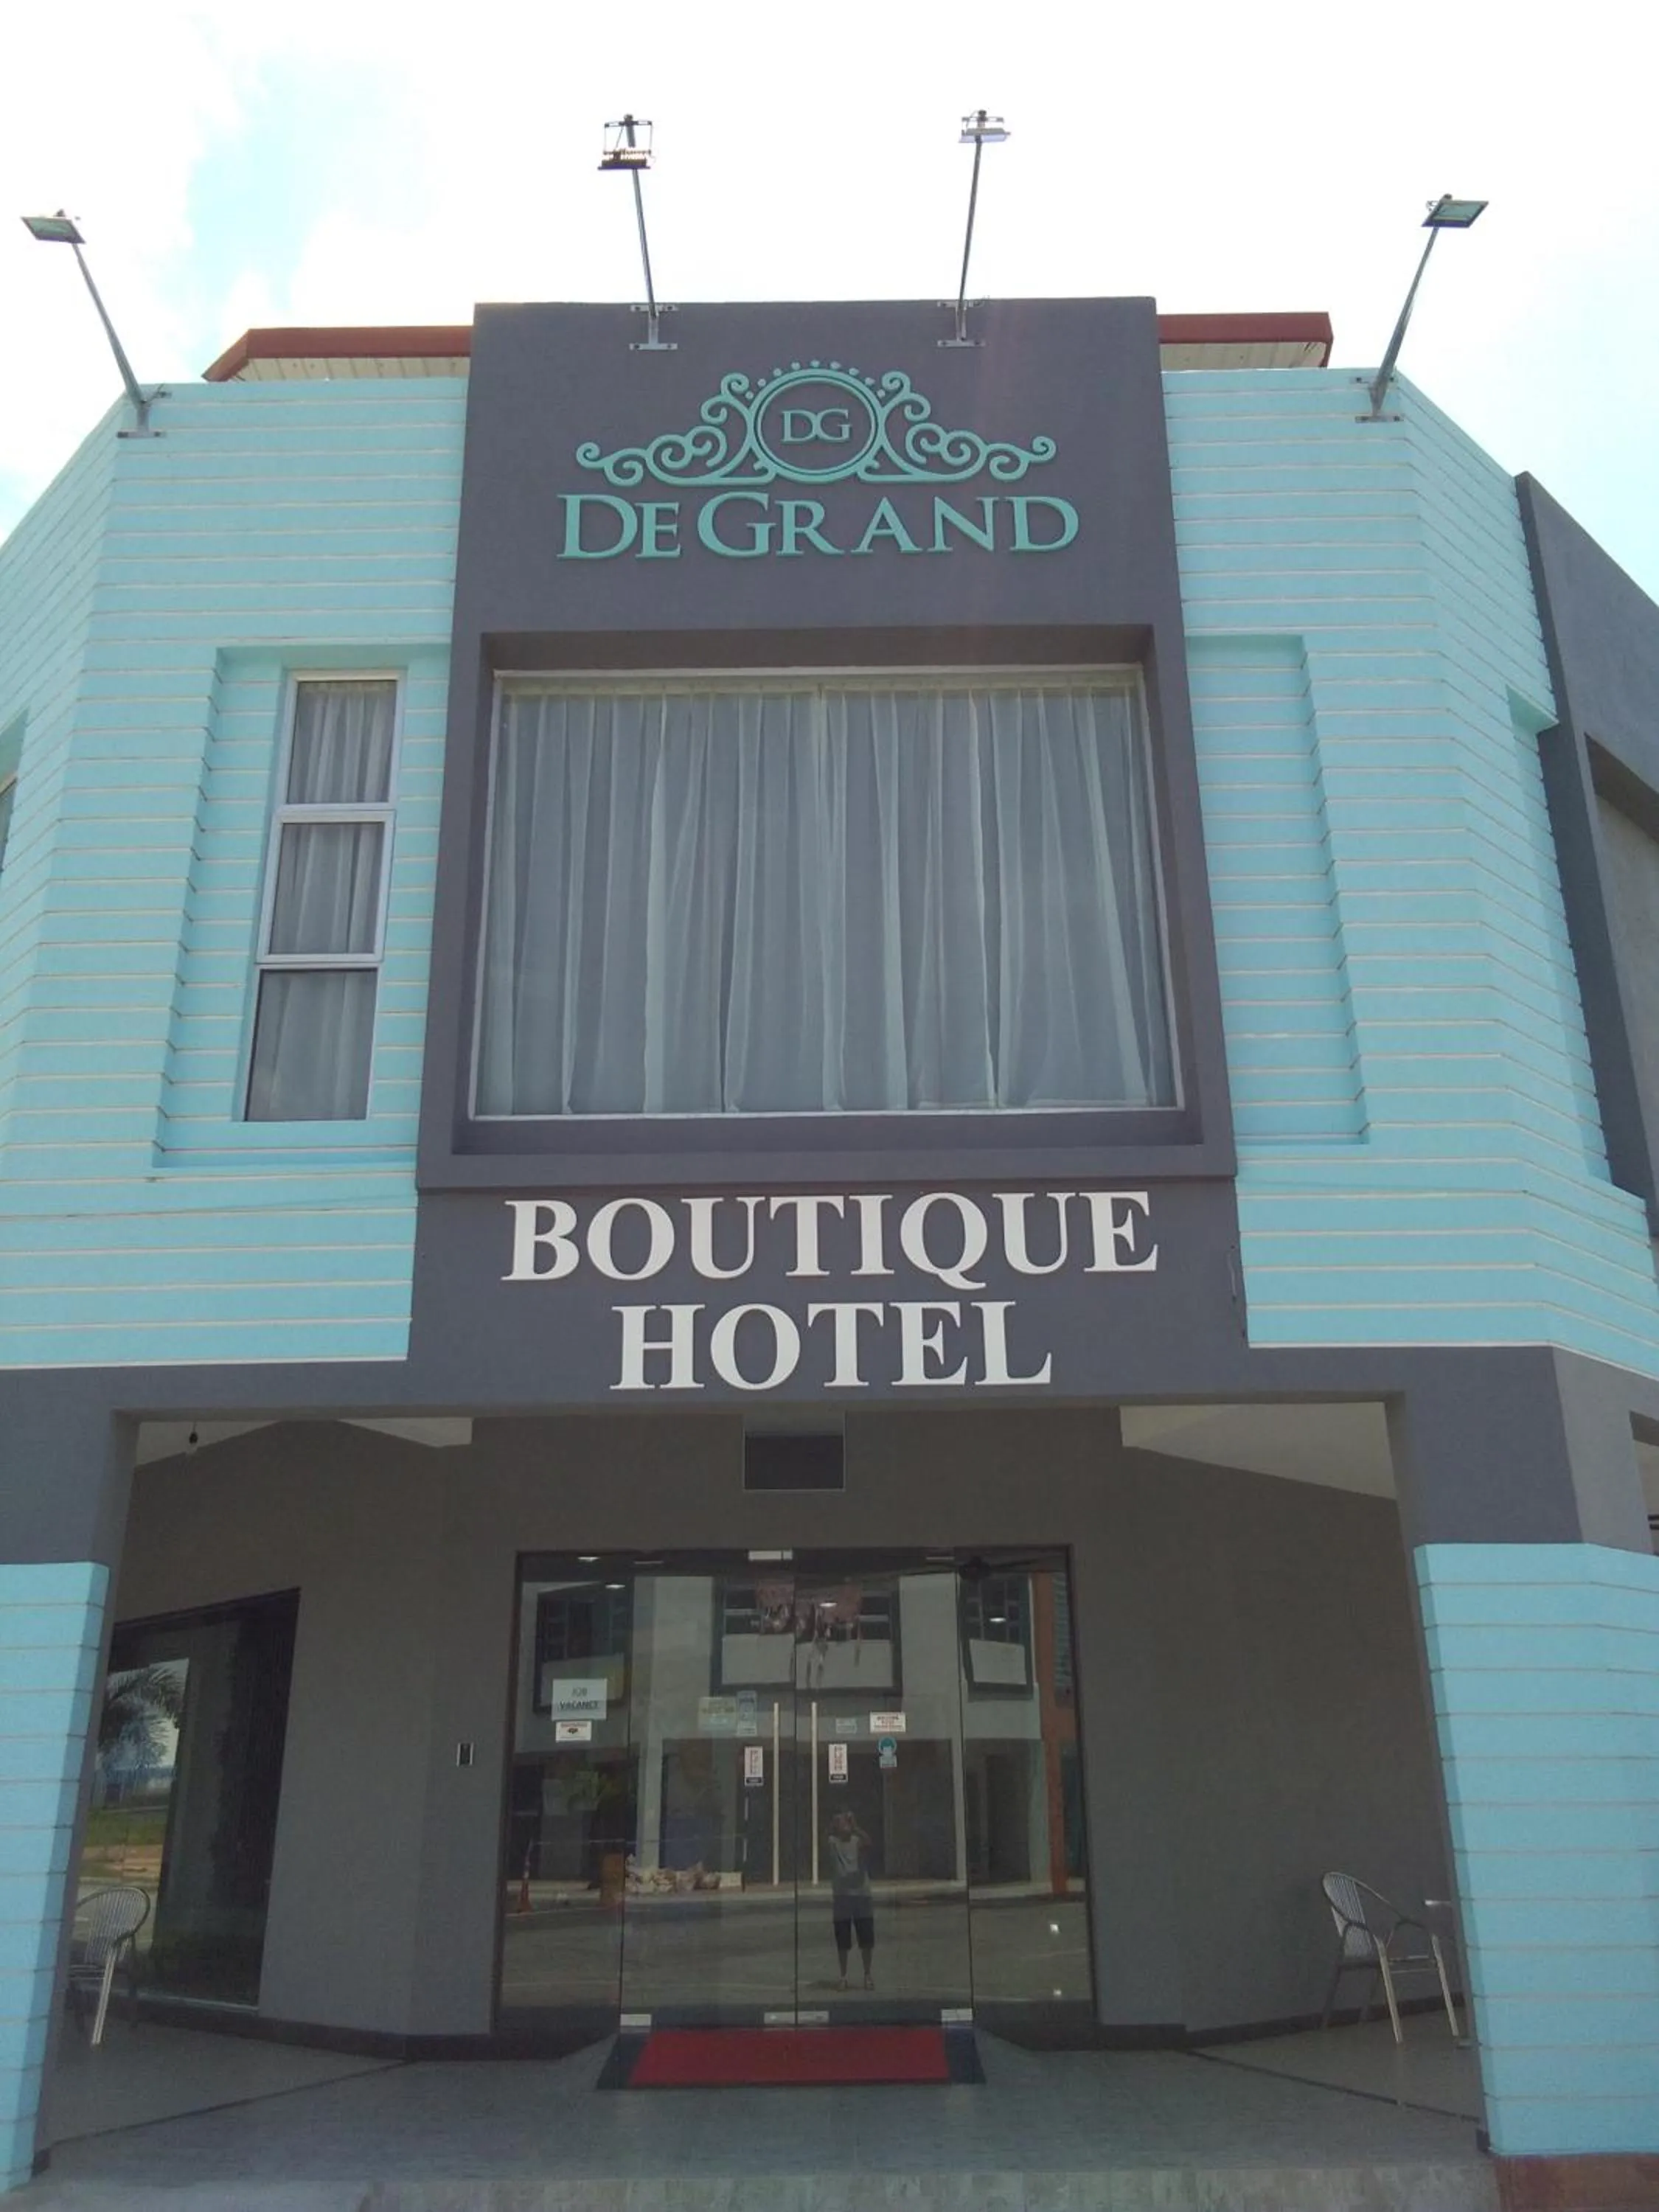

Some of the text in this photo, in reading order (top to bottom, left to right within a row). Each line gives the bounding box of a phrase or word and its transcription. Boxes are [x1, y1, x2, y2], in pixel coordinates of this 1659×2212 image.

[781, 408, 852, 444] DG
[501, 1191, 1158, 1290] BOUTIQUE
[610, 1301, 1051, 1390] HOTEL
